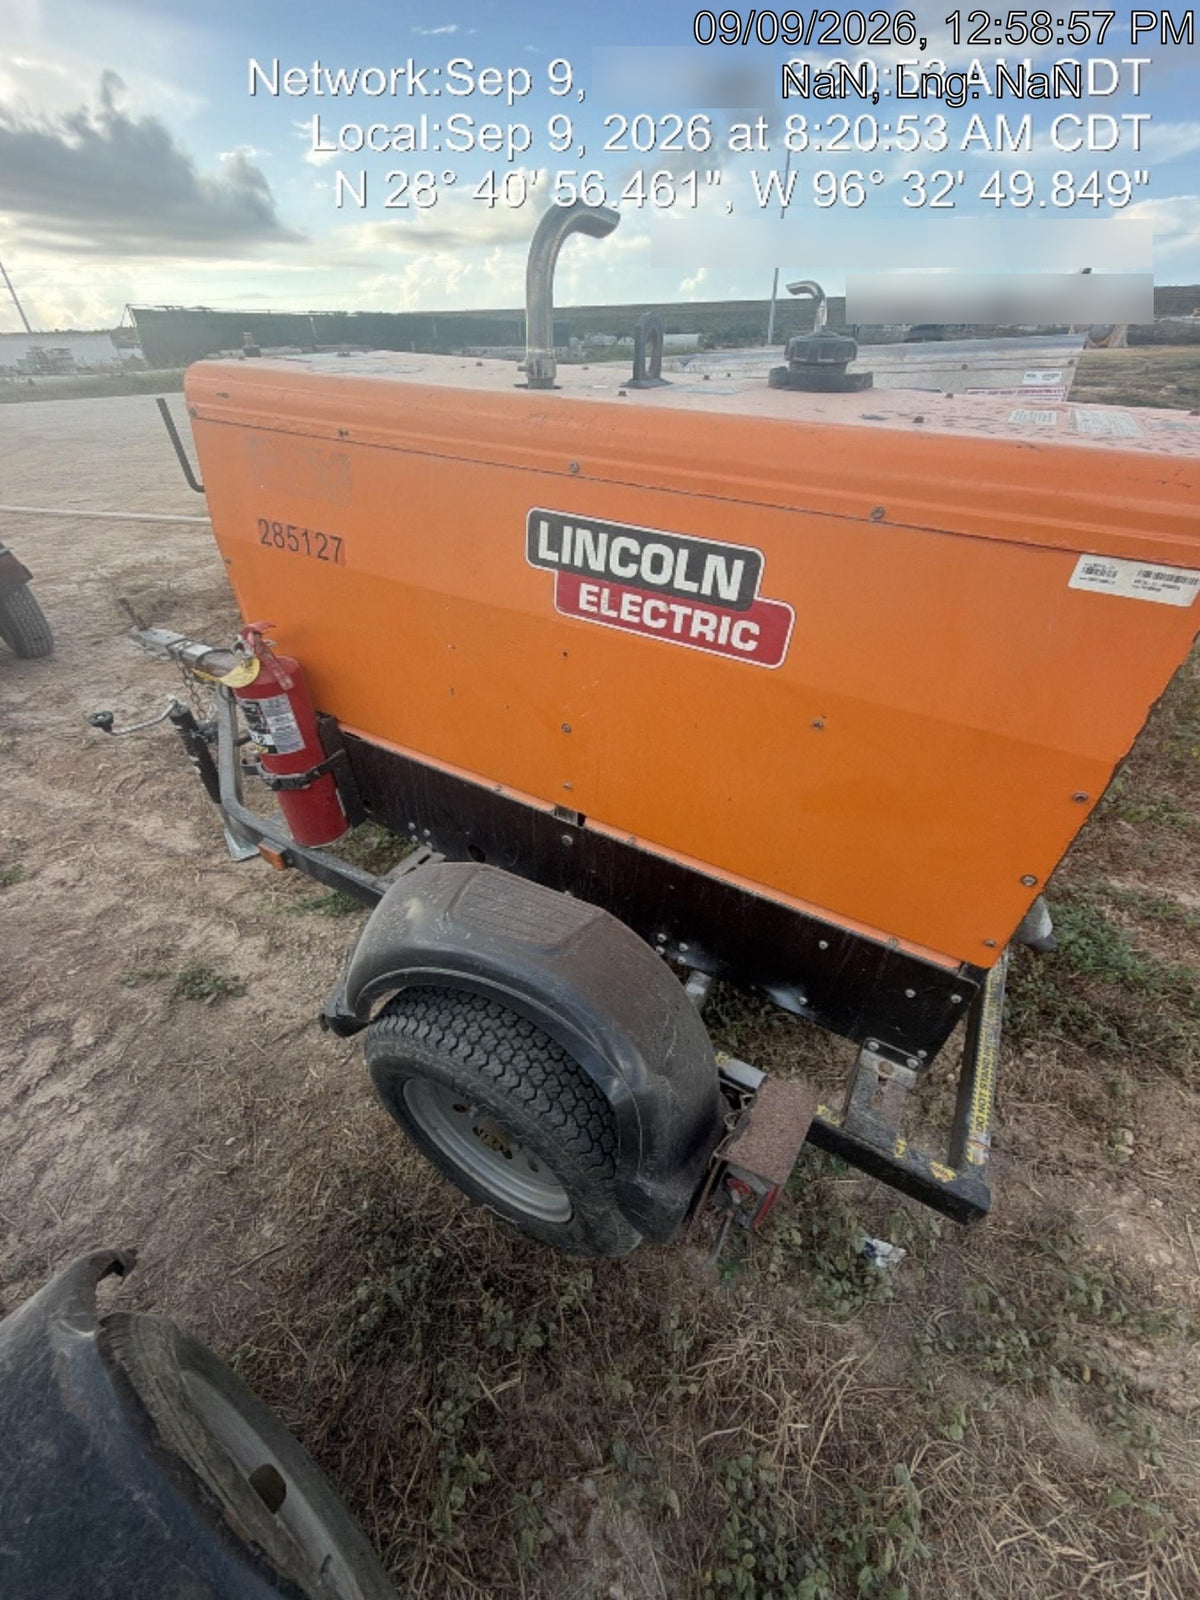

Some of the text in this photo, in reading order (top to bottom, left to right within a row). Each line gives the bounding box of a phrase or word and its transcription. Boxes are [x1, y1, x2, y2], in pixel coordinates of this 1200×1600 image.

[257, 518, 342, 565] 285127
[537, 520, 746, 602] LINCOLN
[578, 582, 761, 653] ELECTRIC
